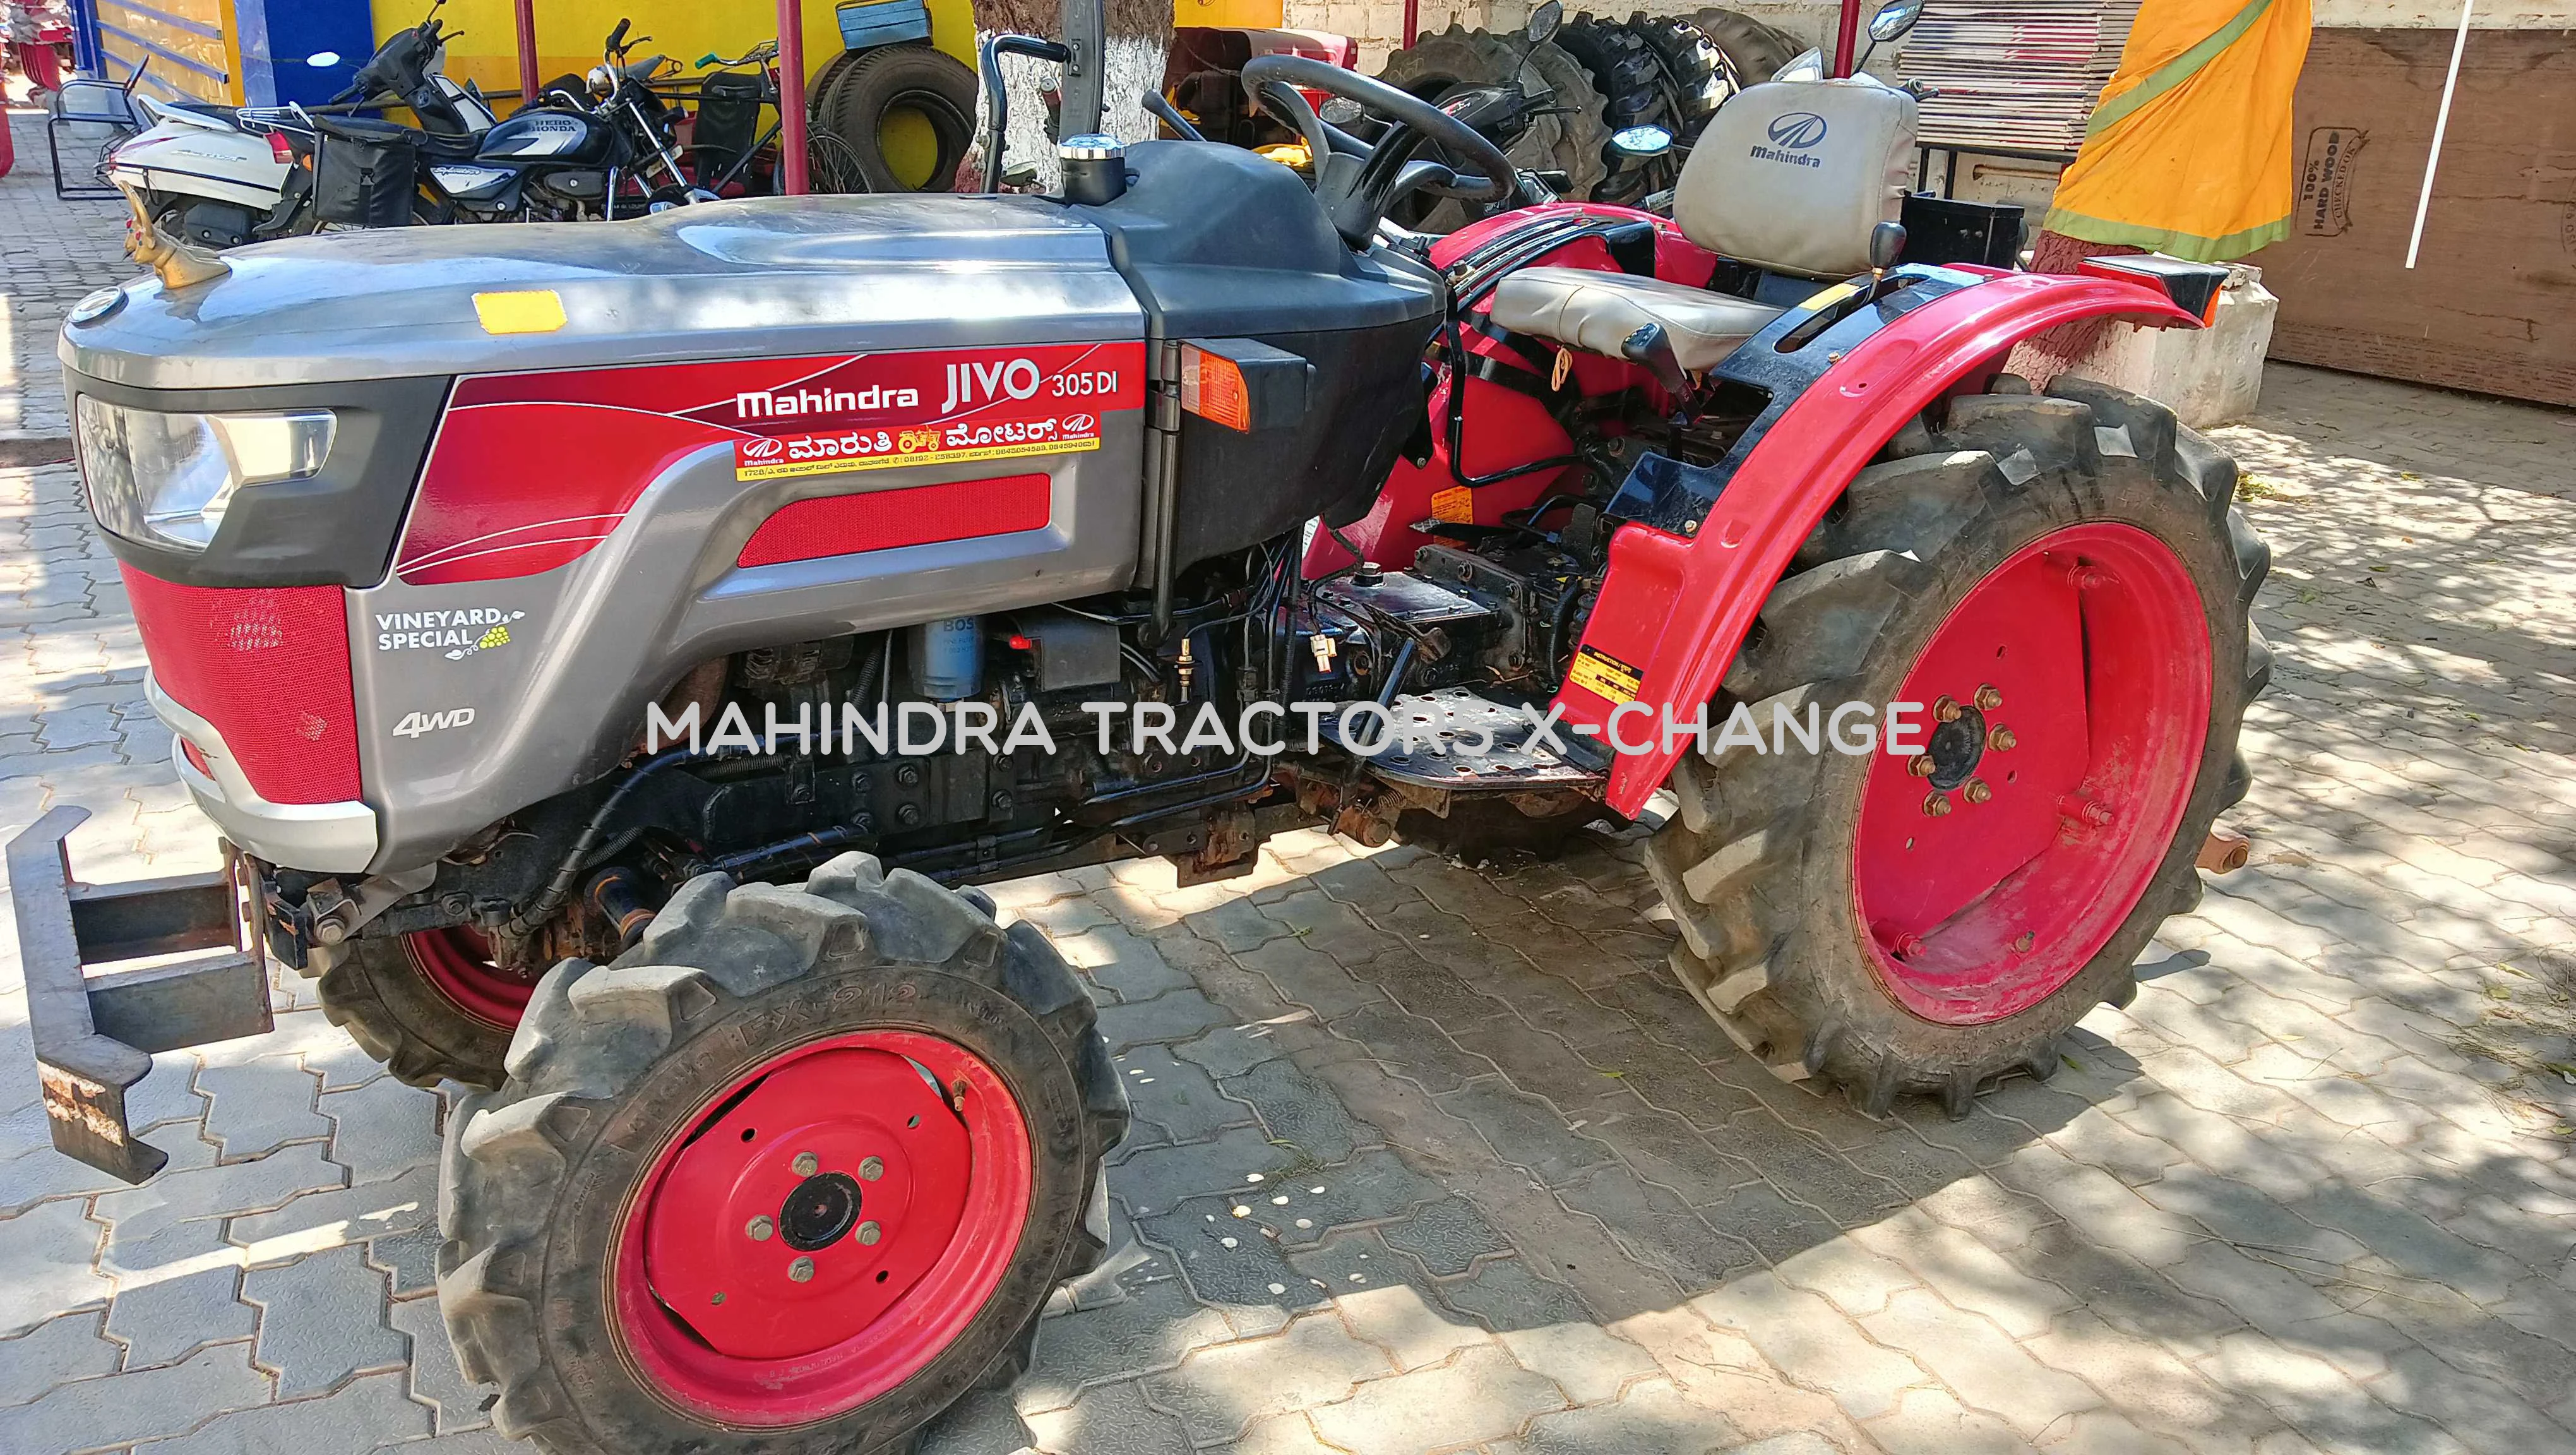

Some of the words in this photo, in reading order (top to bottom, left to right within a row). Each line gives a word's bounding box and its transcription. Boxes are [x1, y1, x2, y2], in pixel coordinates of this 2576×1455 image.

[1750, 145, 1821, 167] Mahindra
[2303, 160, 2320, 201] 100%
[2313, 188, 2329, 229] HARD
[2322, 131, 2339, 183] WOOD
[2334, 165, 2347, 219] CHECKED
[2343, 147, 2356, 163] OK
[736, 385, 919, 418] Mahindra
[941, 357, 1040, 415] JIVO
[788, 431, 892, 459] ಮಾರುತಿ
[1063, 432, 1095, 440] Mahindra
[744, 458, 784, 467] Mahindra
[375, 608, 501, 630] VINEYARD
[378, 629, 473, 650] SPECIAL
[392, 708, 475, 739] 4WD
